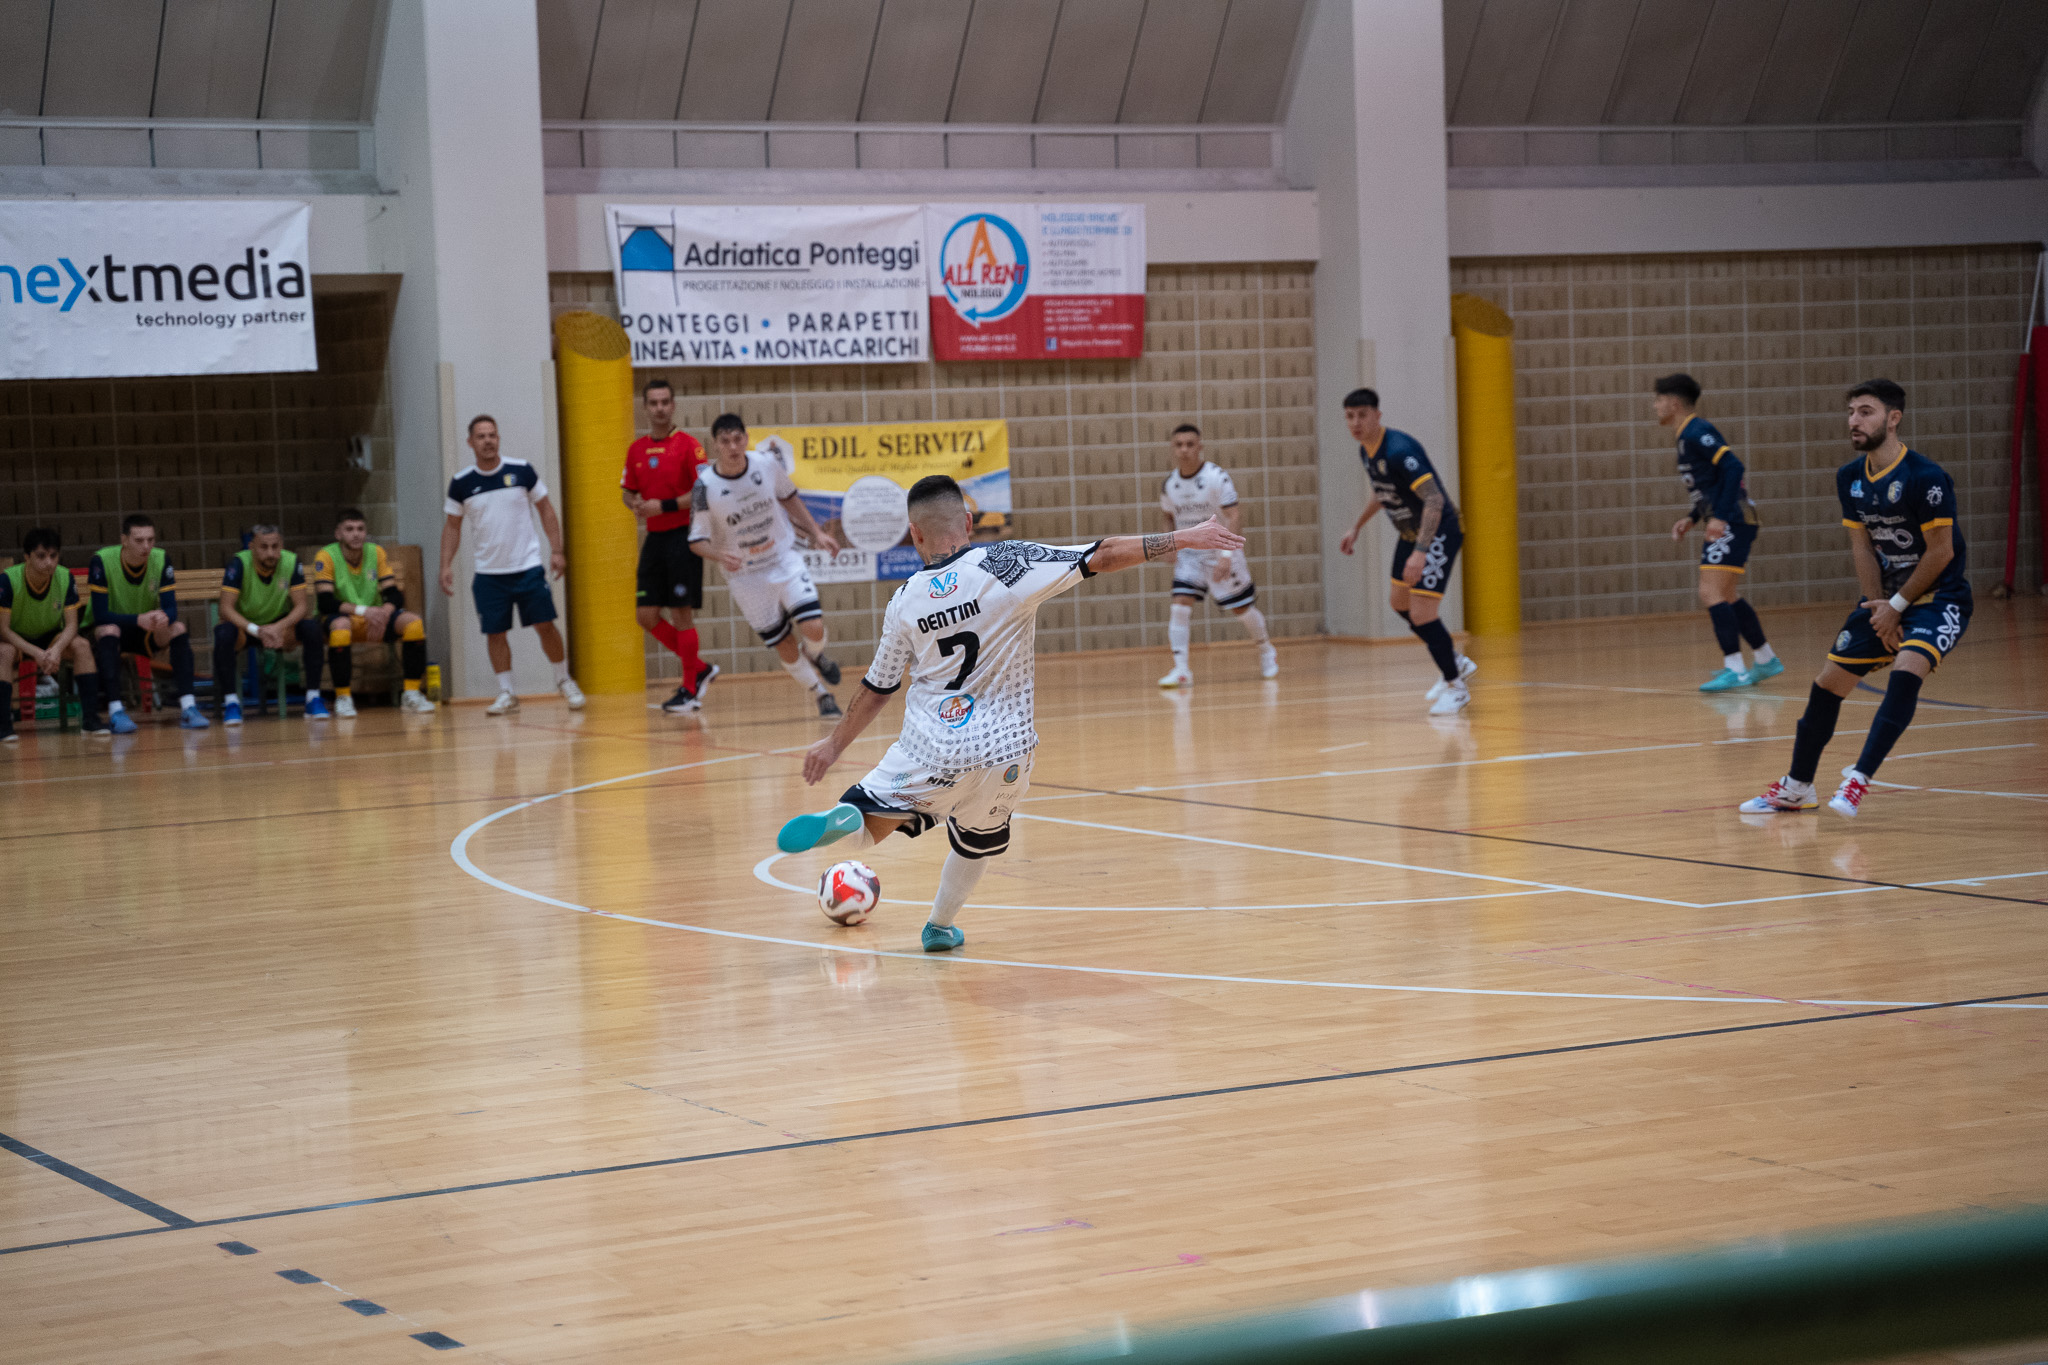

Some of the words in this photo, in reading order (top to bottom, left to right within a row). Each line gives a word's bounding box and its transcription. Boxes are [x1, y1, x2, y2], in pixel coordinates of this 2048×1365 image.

[684, 242, 800, 267] Adriatica
[810, 240, 920, 271] Ponteggi
[942, 263, 977, 286] ALL
[982, 262, 1027, 285] RENT
[136, 311, 237, 329] technology
[242, 309, 307, 326] partner
[621, 313, 749, 334] PONTEGGI
[788, 311, 919, 333] PARAPETTI
[634, 341, 685, 361] INEA
[690, 340, 736, 360] VITA
[754, 337, 919, 359] MONTACARICHI
[801, 435, 867, 460] EDIL
[876, 430, 987, 457] SERVIZI
[917, 598, 982, 634] DENTINI
